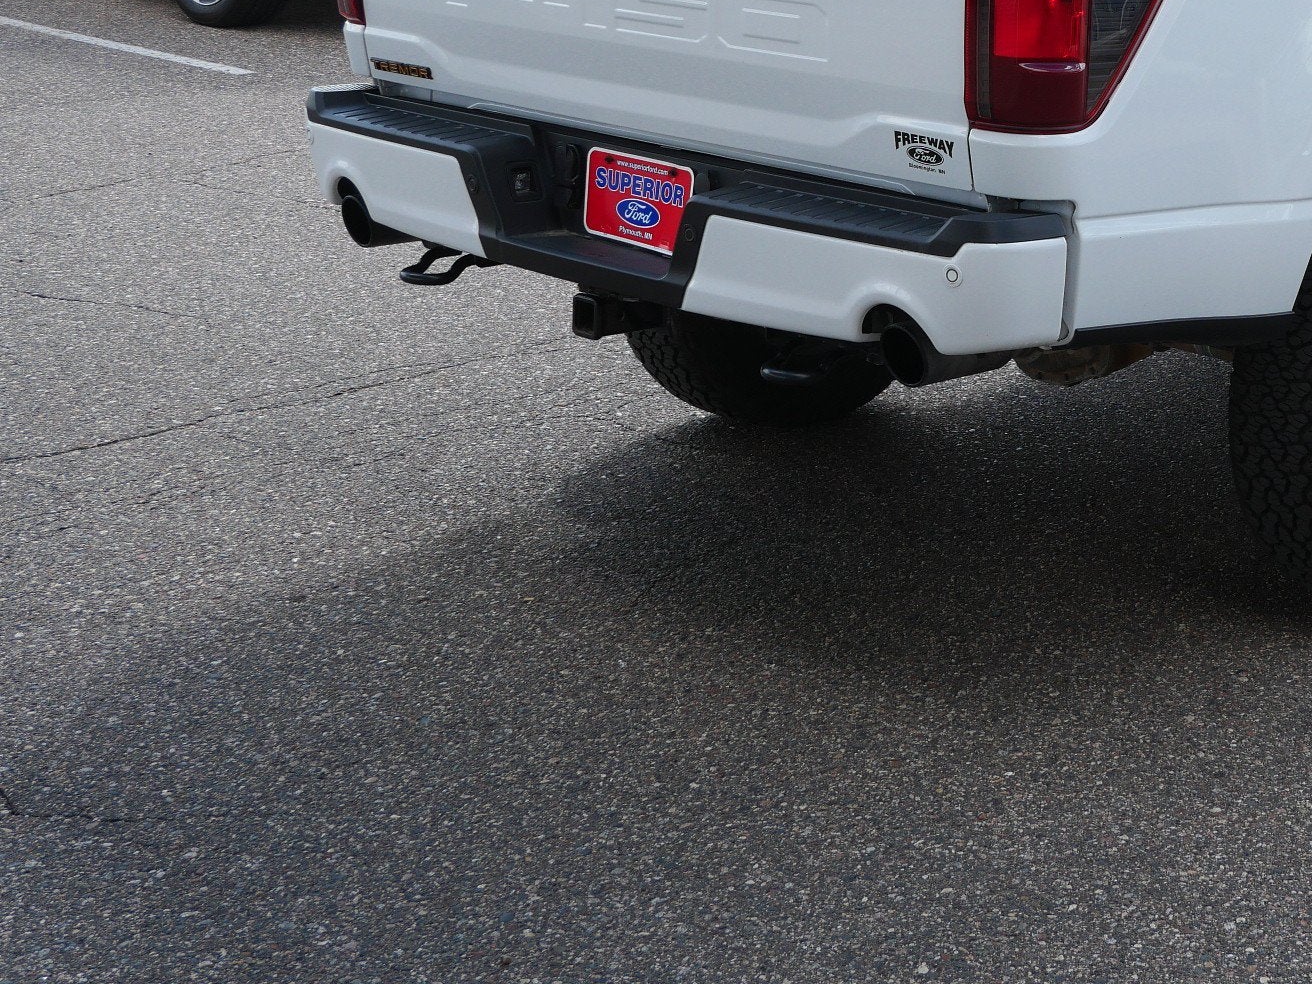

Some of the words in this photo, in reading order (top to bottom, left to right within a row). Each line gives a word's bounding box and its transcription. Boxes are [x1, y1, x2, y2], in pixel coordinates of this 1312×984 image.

[370, 57, 434, 80] TREMOR
[894, 130, 954, 158] FREEWAY
[913, 148, 937, 163] Ford
[616, 159, 669, 176] www.superiorford.com
[595, 166, 685, 208] SUPERIOR
[624, 201, 653, 224] Ford
[644, 232, 653, 241] MN
